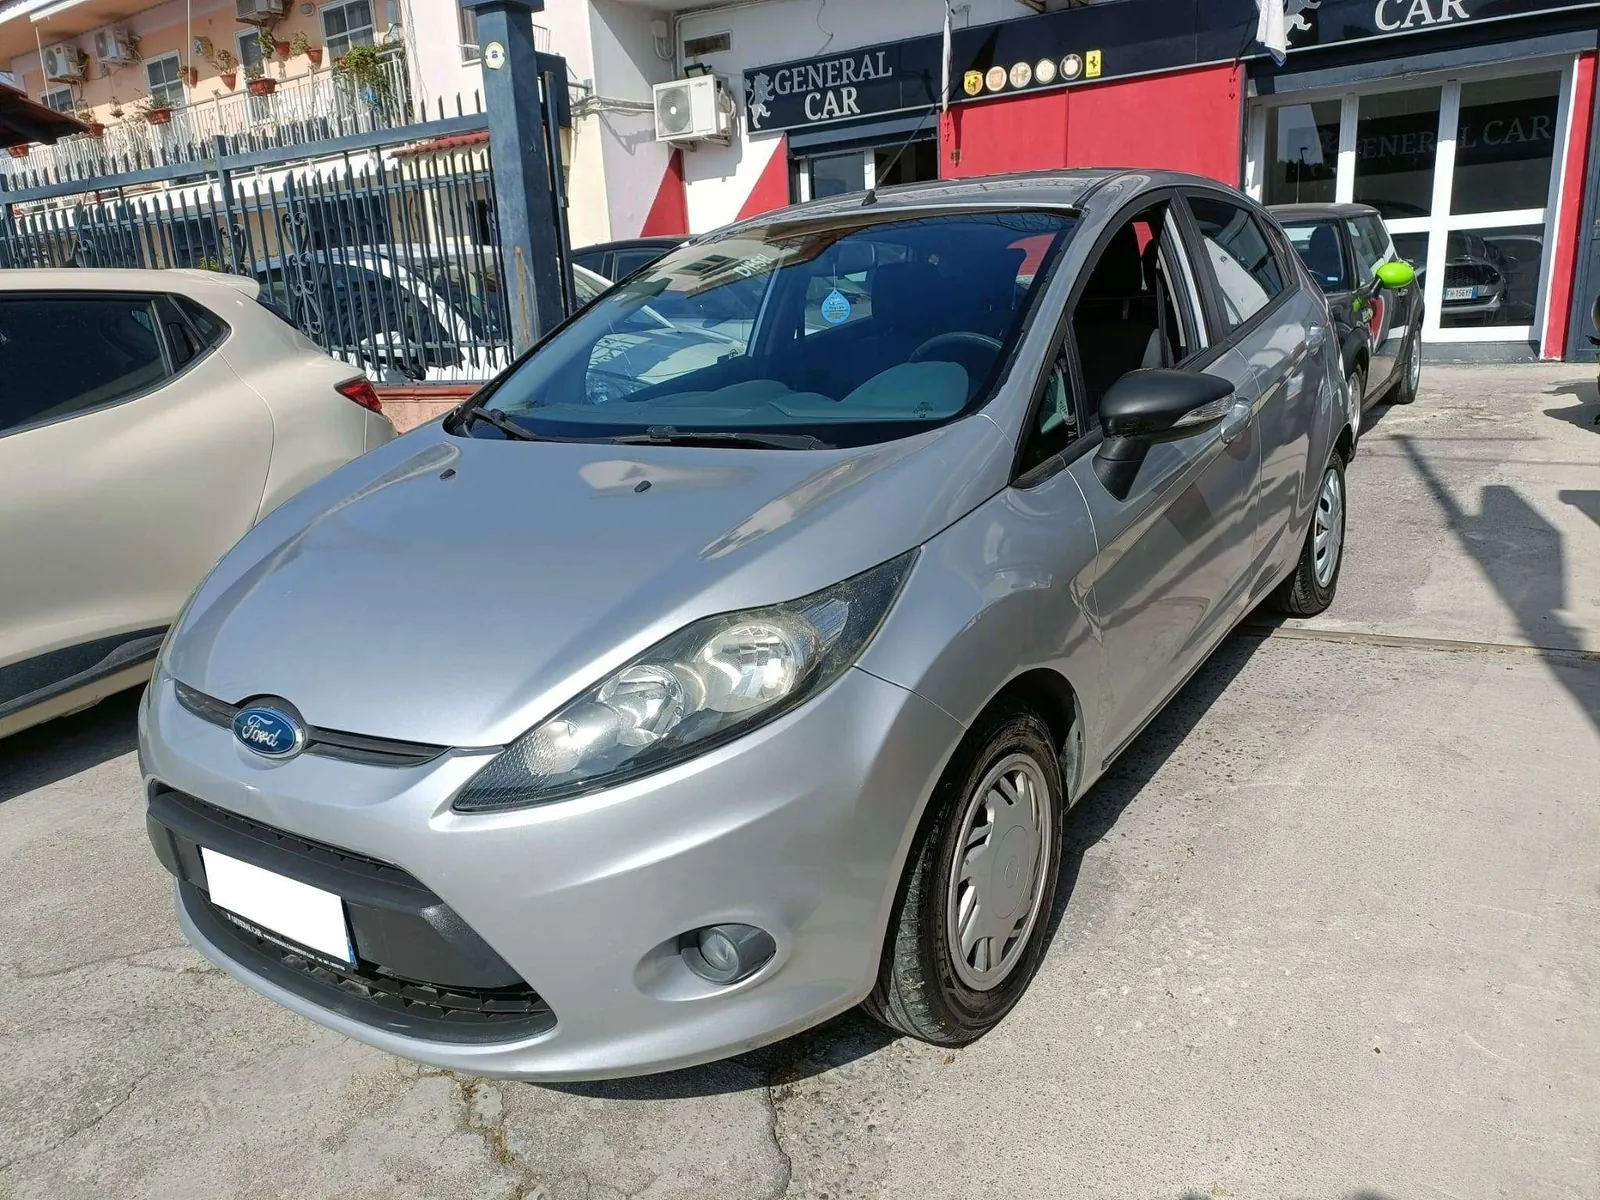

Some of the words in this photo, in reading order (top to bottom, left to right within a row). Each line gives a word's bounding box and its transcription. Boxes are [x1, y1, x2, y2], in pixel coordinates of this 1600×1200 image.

[1375, 0, 1470, 31] CAR
[774, 51, 893, 95] GENERAL
[804, 86, 861, 121] CAR
[1360, 126, 1476, 159] ENERL
[1483, 115, 1553, 146] CAR
[241, 714, 282, 747] Ford
